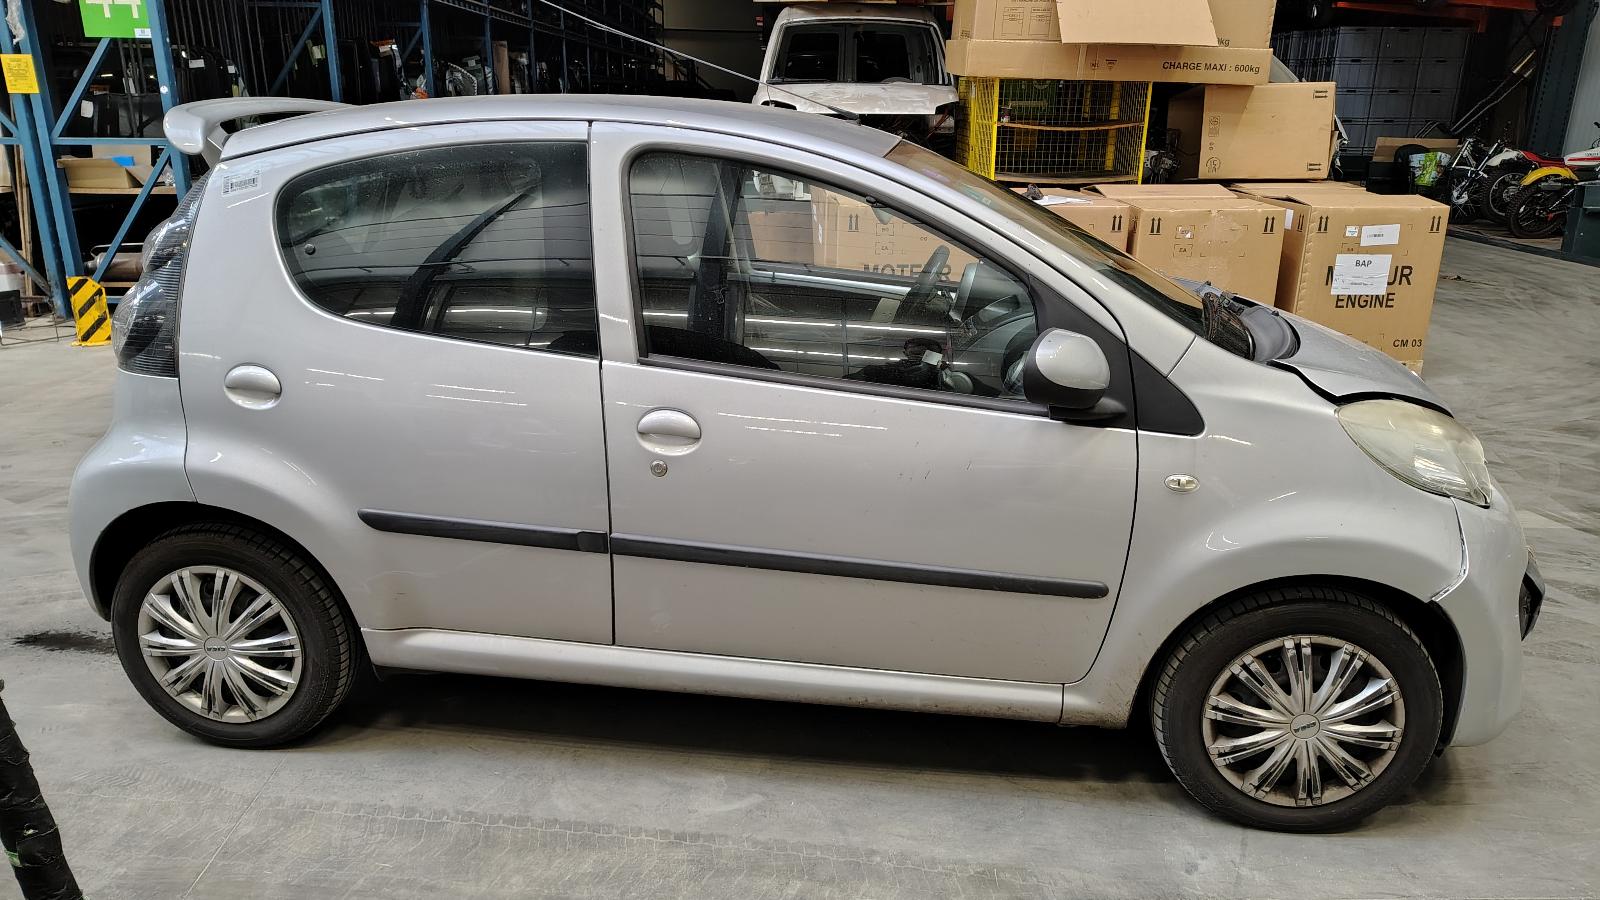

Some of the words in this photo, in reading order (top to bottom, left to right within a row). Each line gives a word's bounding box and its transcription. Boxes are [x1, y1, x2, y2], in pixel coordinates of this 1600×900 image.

[1162, 61, 1202, 71] CHARGE
[1204, 63, 1227, 72] MAXI
[1234, 64, 1260, 74] 600kg
[1355, 259, 1373, 268] BAP
[1335, 292, 1396, 309] ENGINE
[1392, 339, 1409, 348] CM
[1411, 339, 1423, 348] 03
